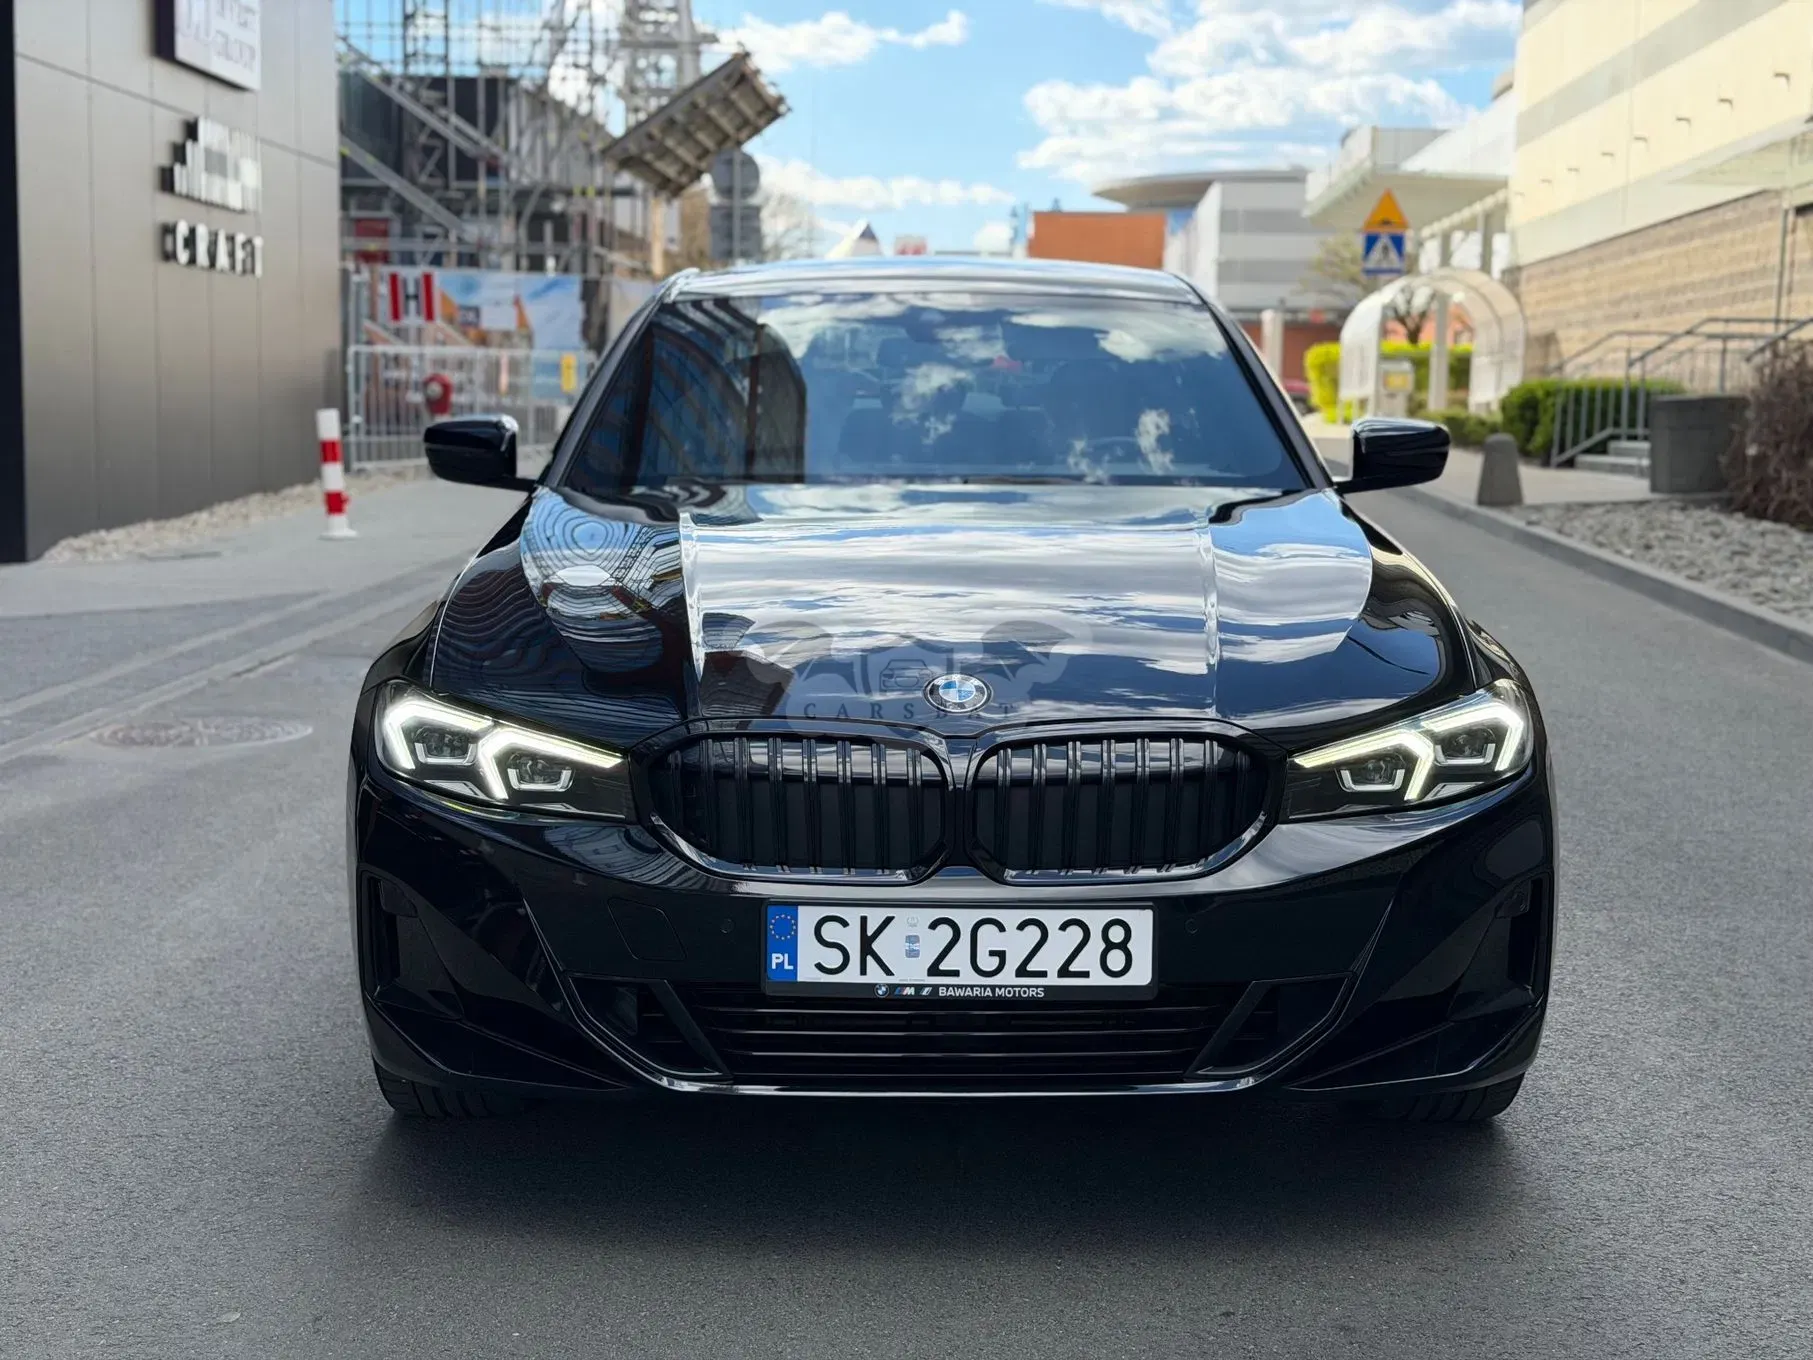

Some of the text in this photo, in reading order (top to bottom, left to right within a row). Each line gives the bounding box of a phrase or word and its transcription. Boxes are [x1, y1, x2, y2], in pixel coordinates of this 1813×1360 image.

[175, 219, 264, 278] CRAFT
[771, 953, 794, 970] PL
[813, 914, 1133, 978] SK 2G228
[938, 986, 993, 998] BAWARIA
[995, 987, 1045, 998] MOTORS
